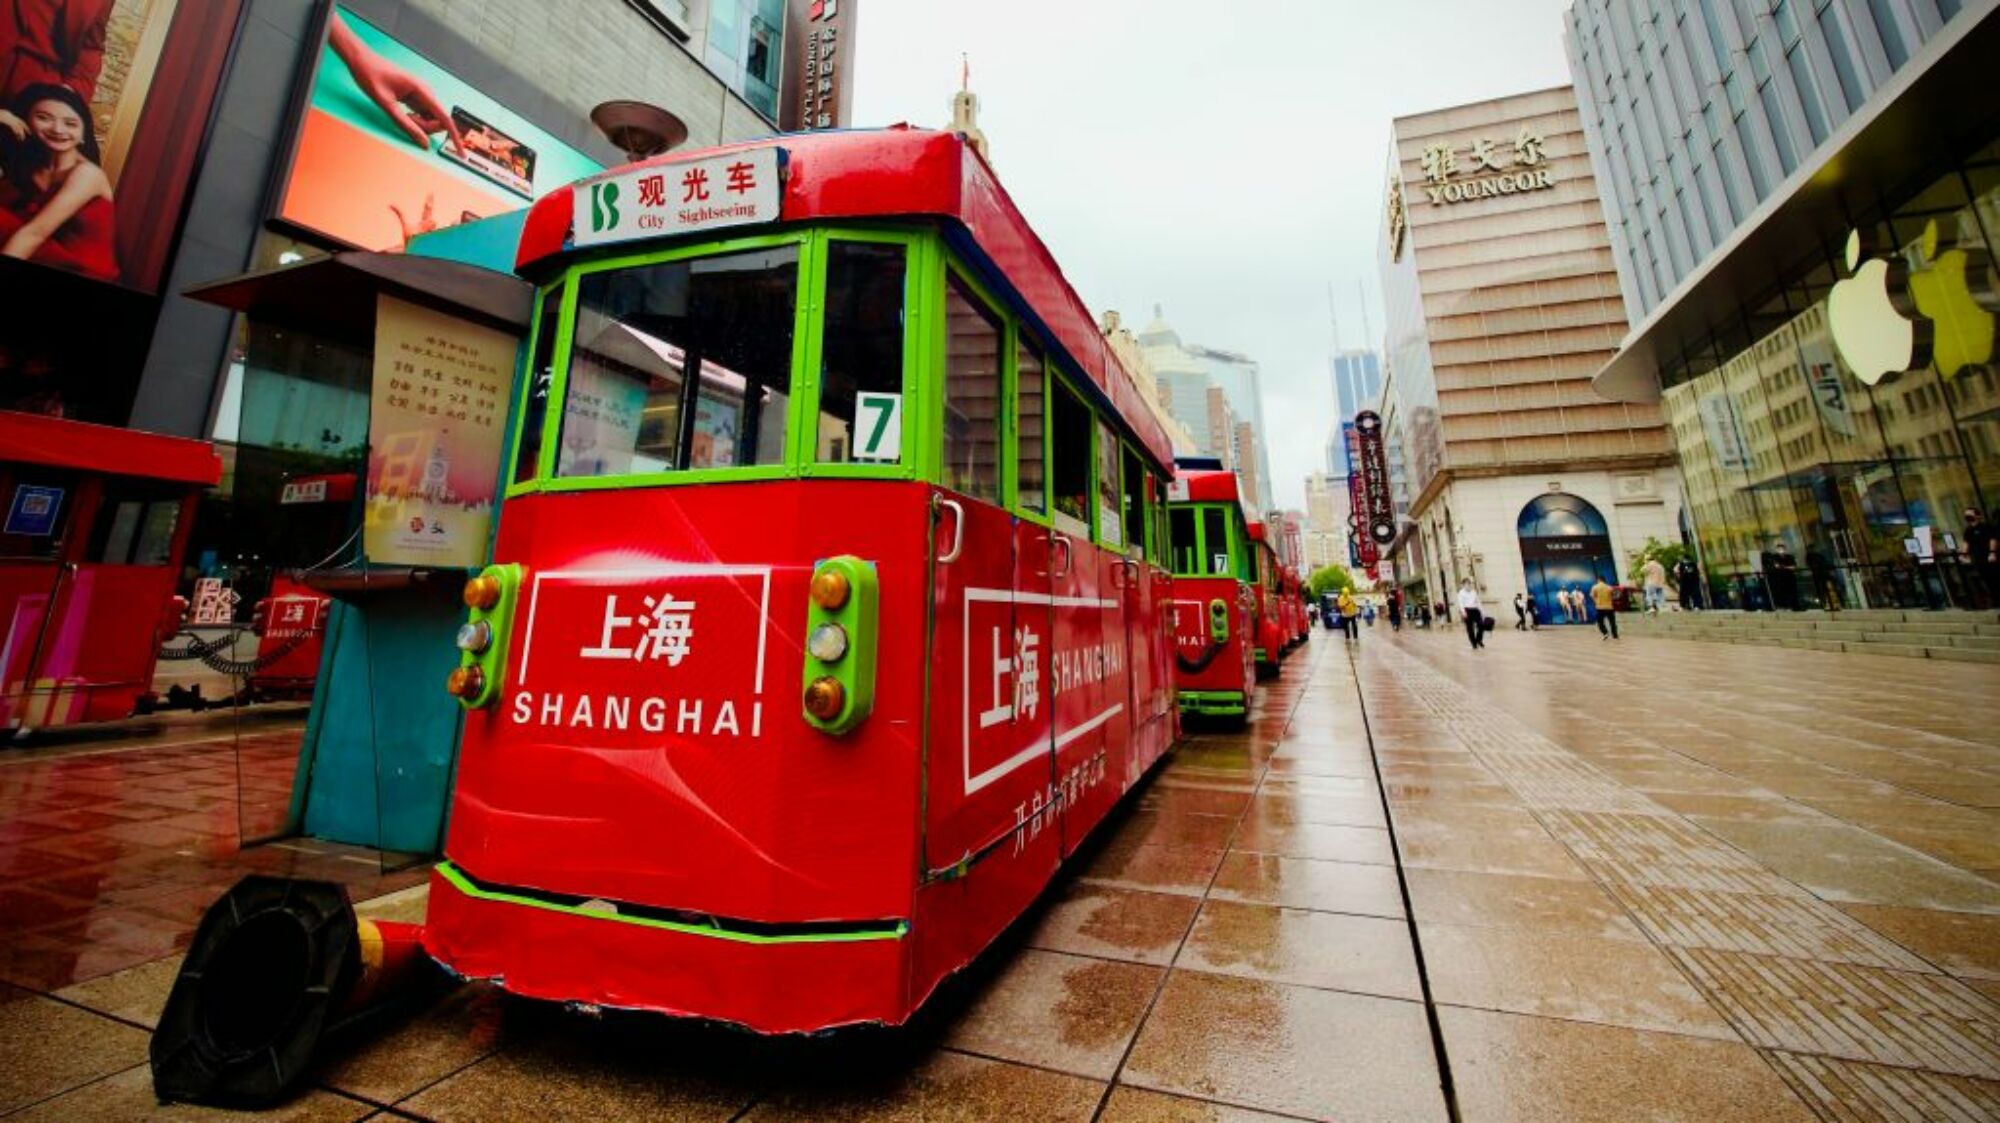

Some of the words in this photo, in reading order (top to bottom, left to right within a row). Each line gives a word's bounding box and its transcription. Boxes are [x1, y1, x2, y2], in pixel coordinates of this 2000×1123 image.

[1421, 126, 1548, 184] 雅戈尔
[638, 162, 757, 208] 观光车
[1425, 170, 1555, 206] YOUNGOR
[638, 213, 665, 230] City
[678, 202, 757, 224] Sightseeing
[863, 398, 895, 454] 7
[1216, 557, 1226, 571] 7
[580, 593, 696, 667] 上海
[979, 623, 1040, 729] 上海
[1051, 642, 1124, 696] SHANGHAI
[512, 691, 763, 737] SHANGHAI
